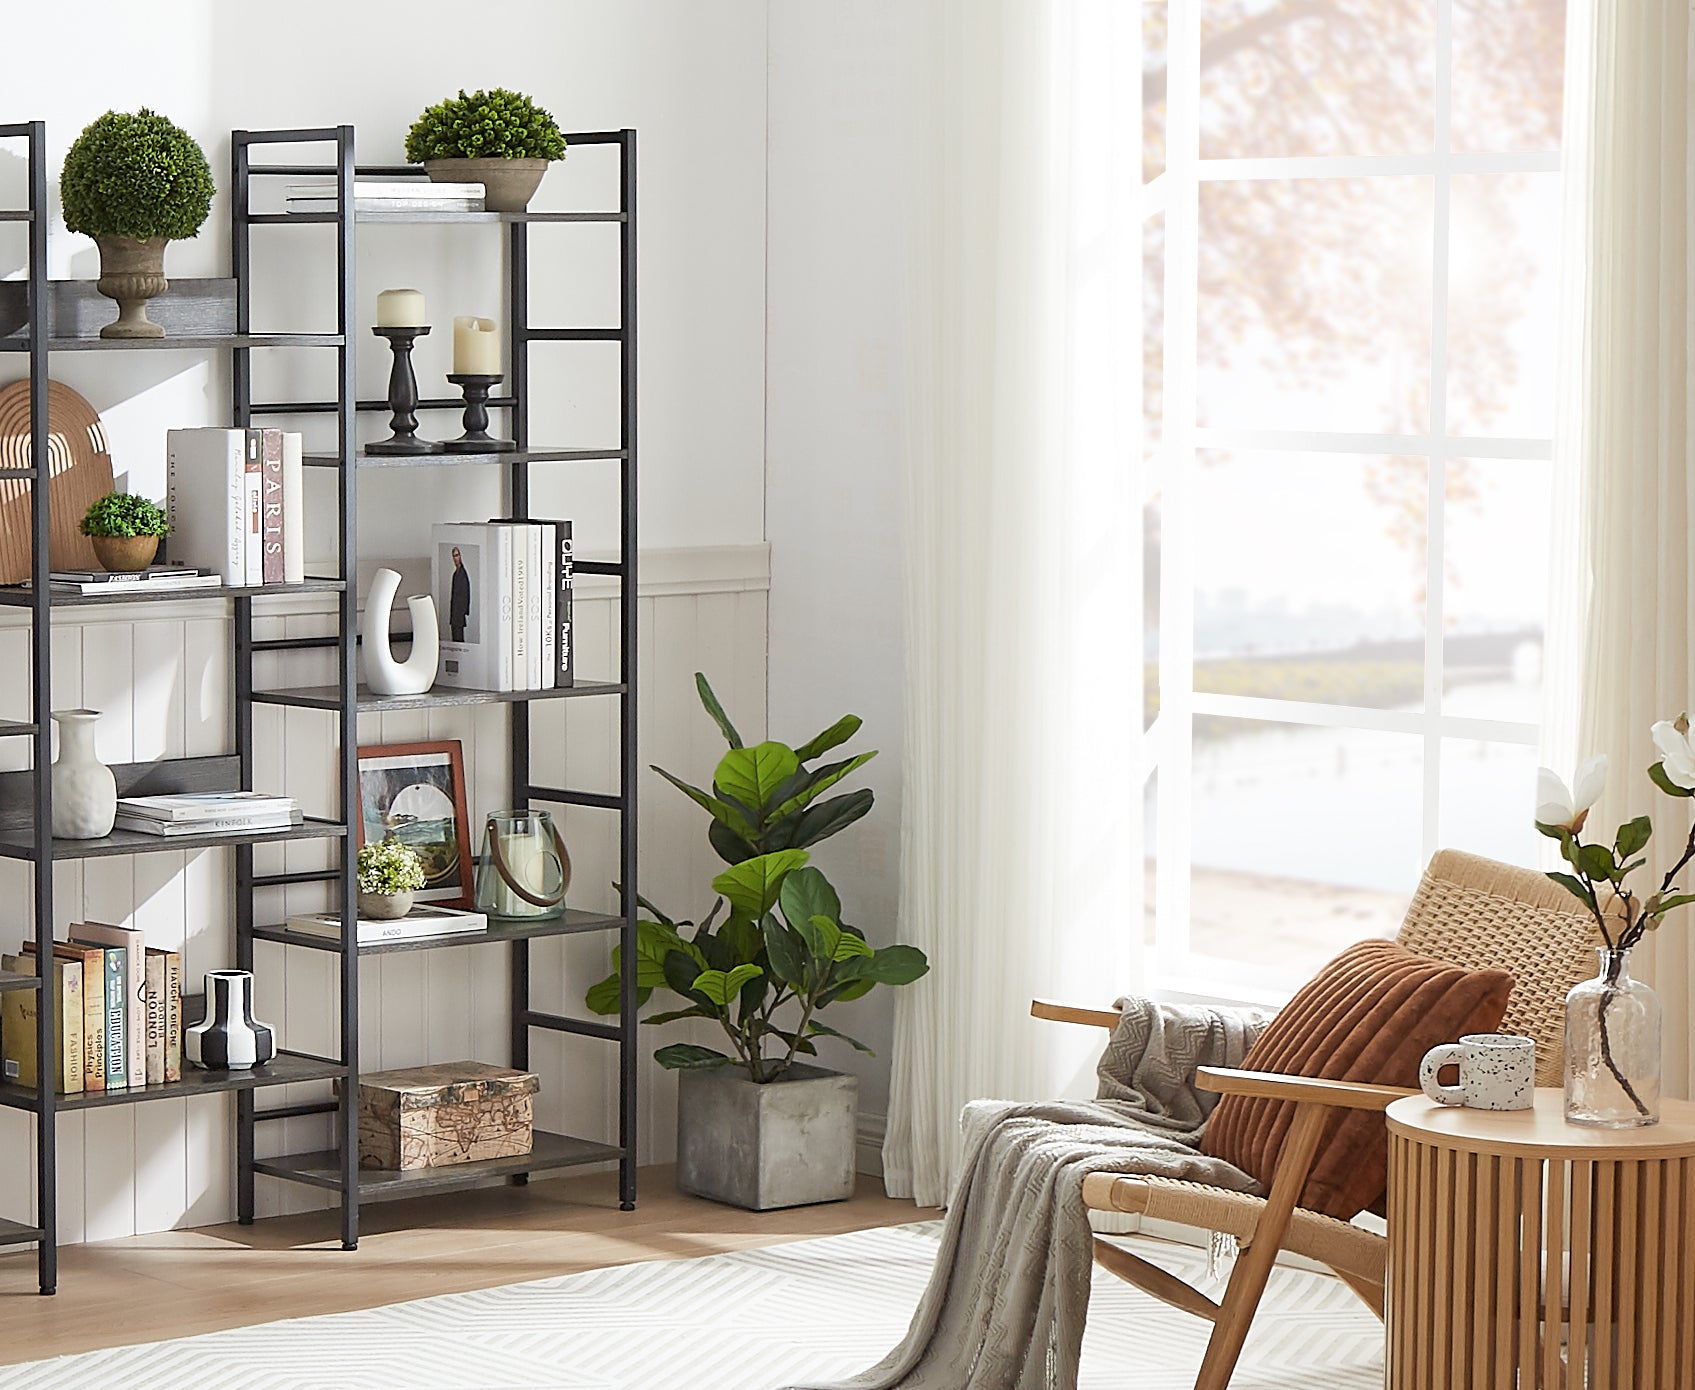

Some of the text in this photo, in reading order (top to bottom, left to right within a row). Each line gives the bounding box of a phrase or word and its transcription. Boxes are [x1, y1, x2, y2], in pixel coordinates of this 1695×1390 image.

[266, 457, 281, 555] PARIS
[502, 595, 511, 622] COS
[531, 595, 539, 621] COS
[562, 623, 570, 672] Furniture
[215, 818, 253, 828] KINFOLK
[111, 1009, 122, 1074] EDUCATION
[149, 992, 157, 1048] LONDON
[71, 1033, 79, 1082] FASHION
[87, 1035, 95, 1074] Physics
[95, 1029, 103, 1079] Principles
